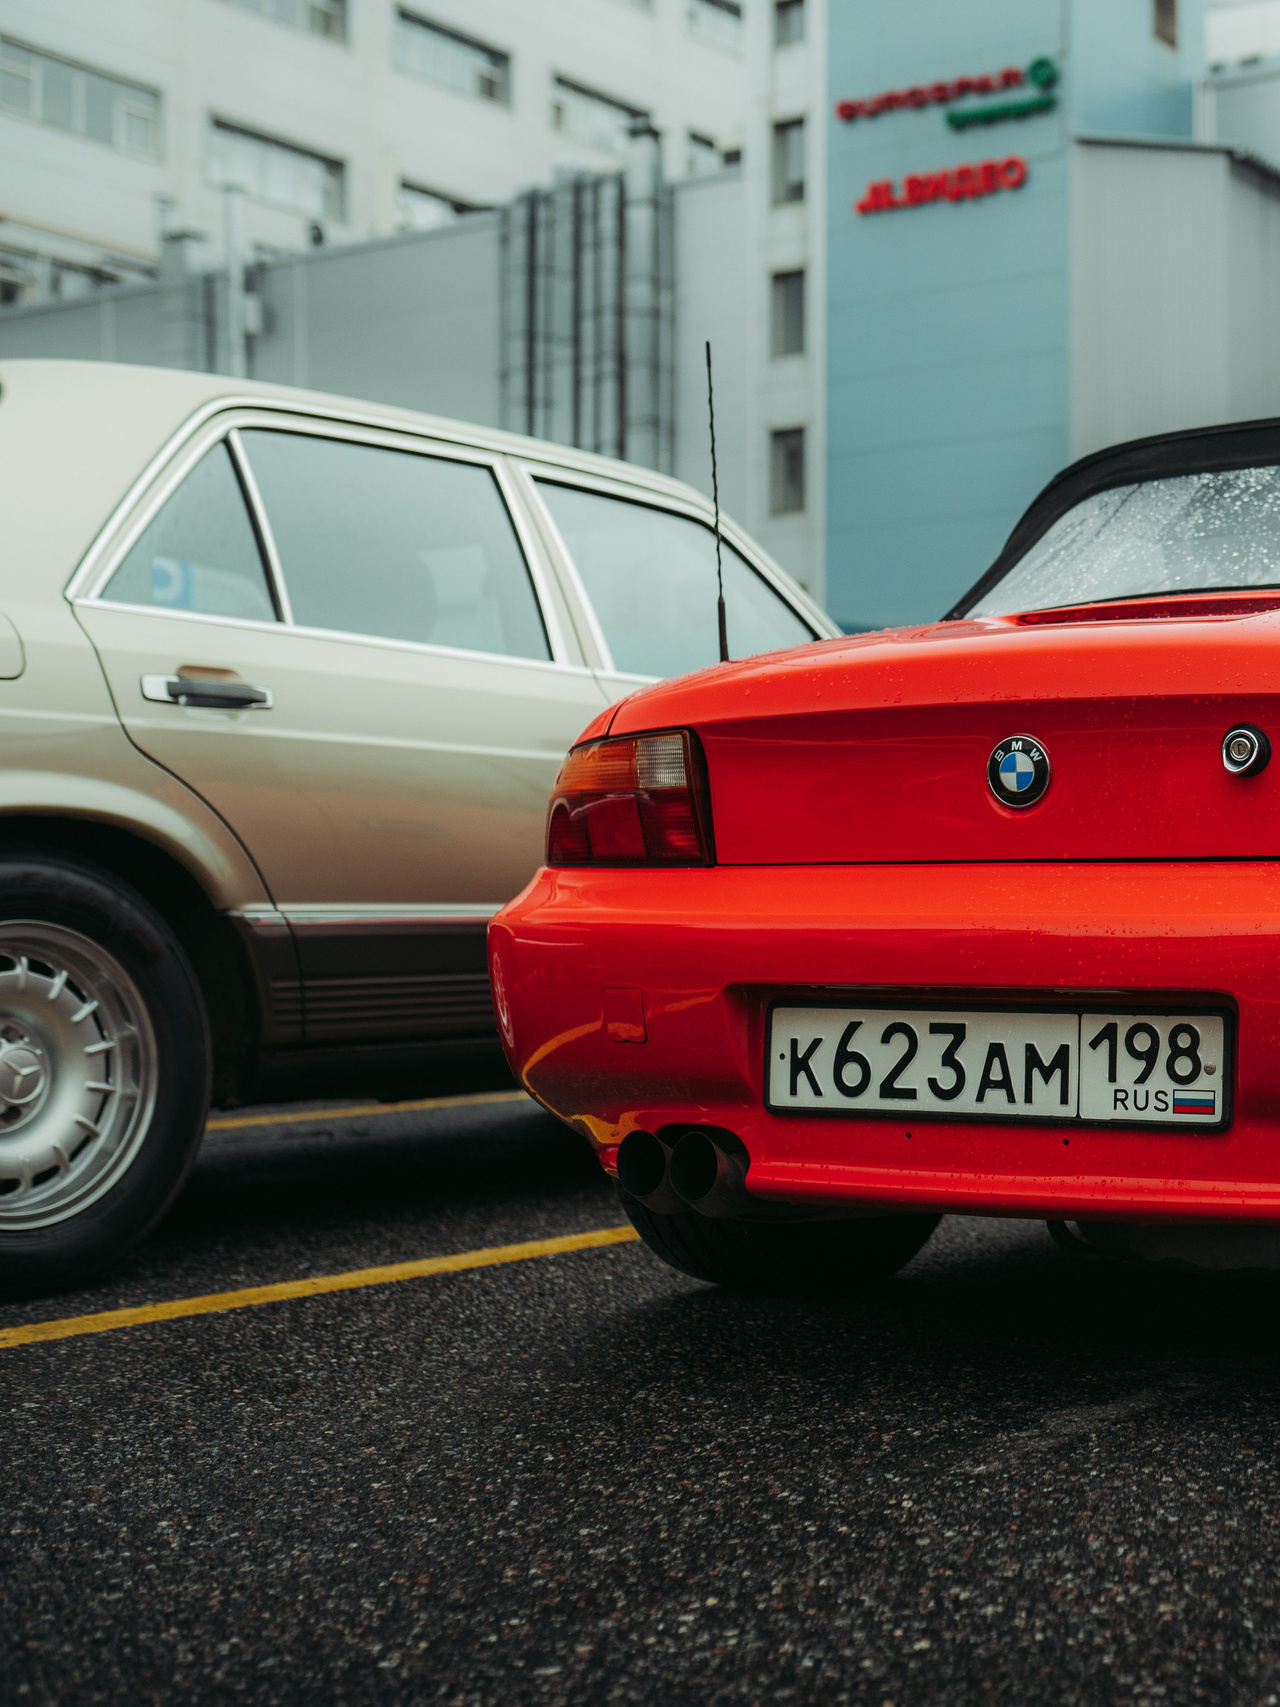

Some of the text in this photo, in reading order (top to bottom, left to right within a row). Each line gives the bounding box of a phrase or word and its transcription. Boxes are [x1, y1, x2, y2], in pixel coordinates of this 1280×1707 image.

[994, 740, 1042, 763] BMW
[789, 1020, 1202, 1105] K623AM 198
[1112, 1088, 1170, 1113] RUS
